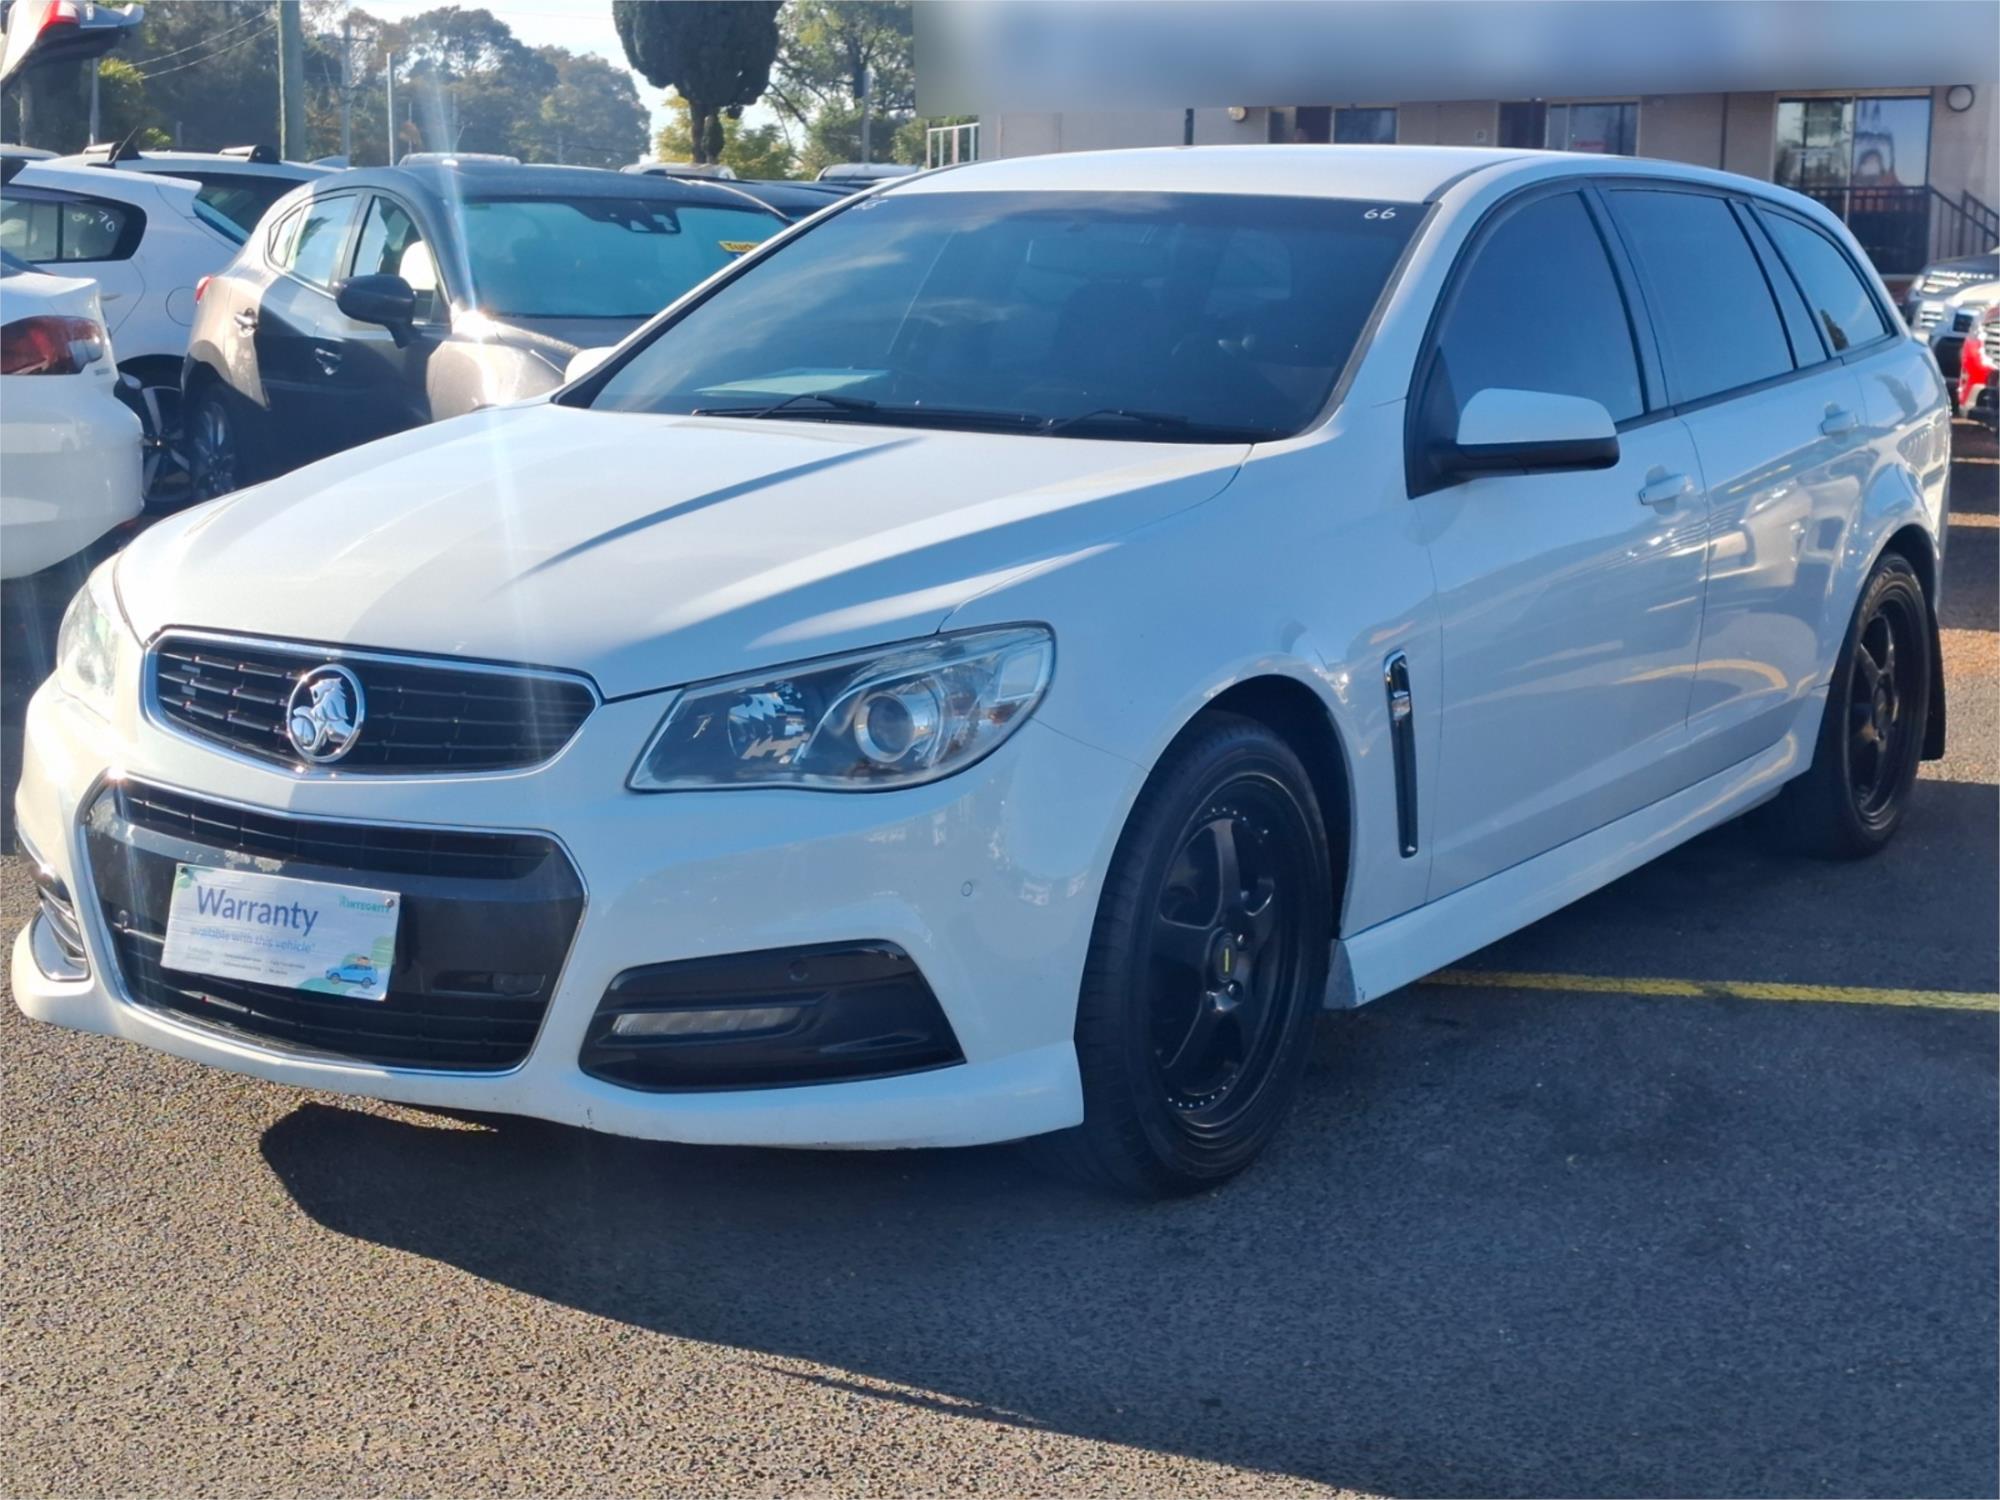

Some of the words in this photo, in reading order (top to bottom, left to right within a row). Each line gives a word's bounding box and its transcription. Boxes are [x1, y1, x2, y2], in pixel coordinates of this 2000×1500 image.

[1363, 207, 1397, 219] 66
[197, 886, 318, 936] Warranty
[255, 935, 273, 947] this
